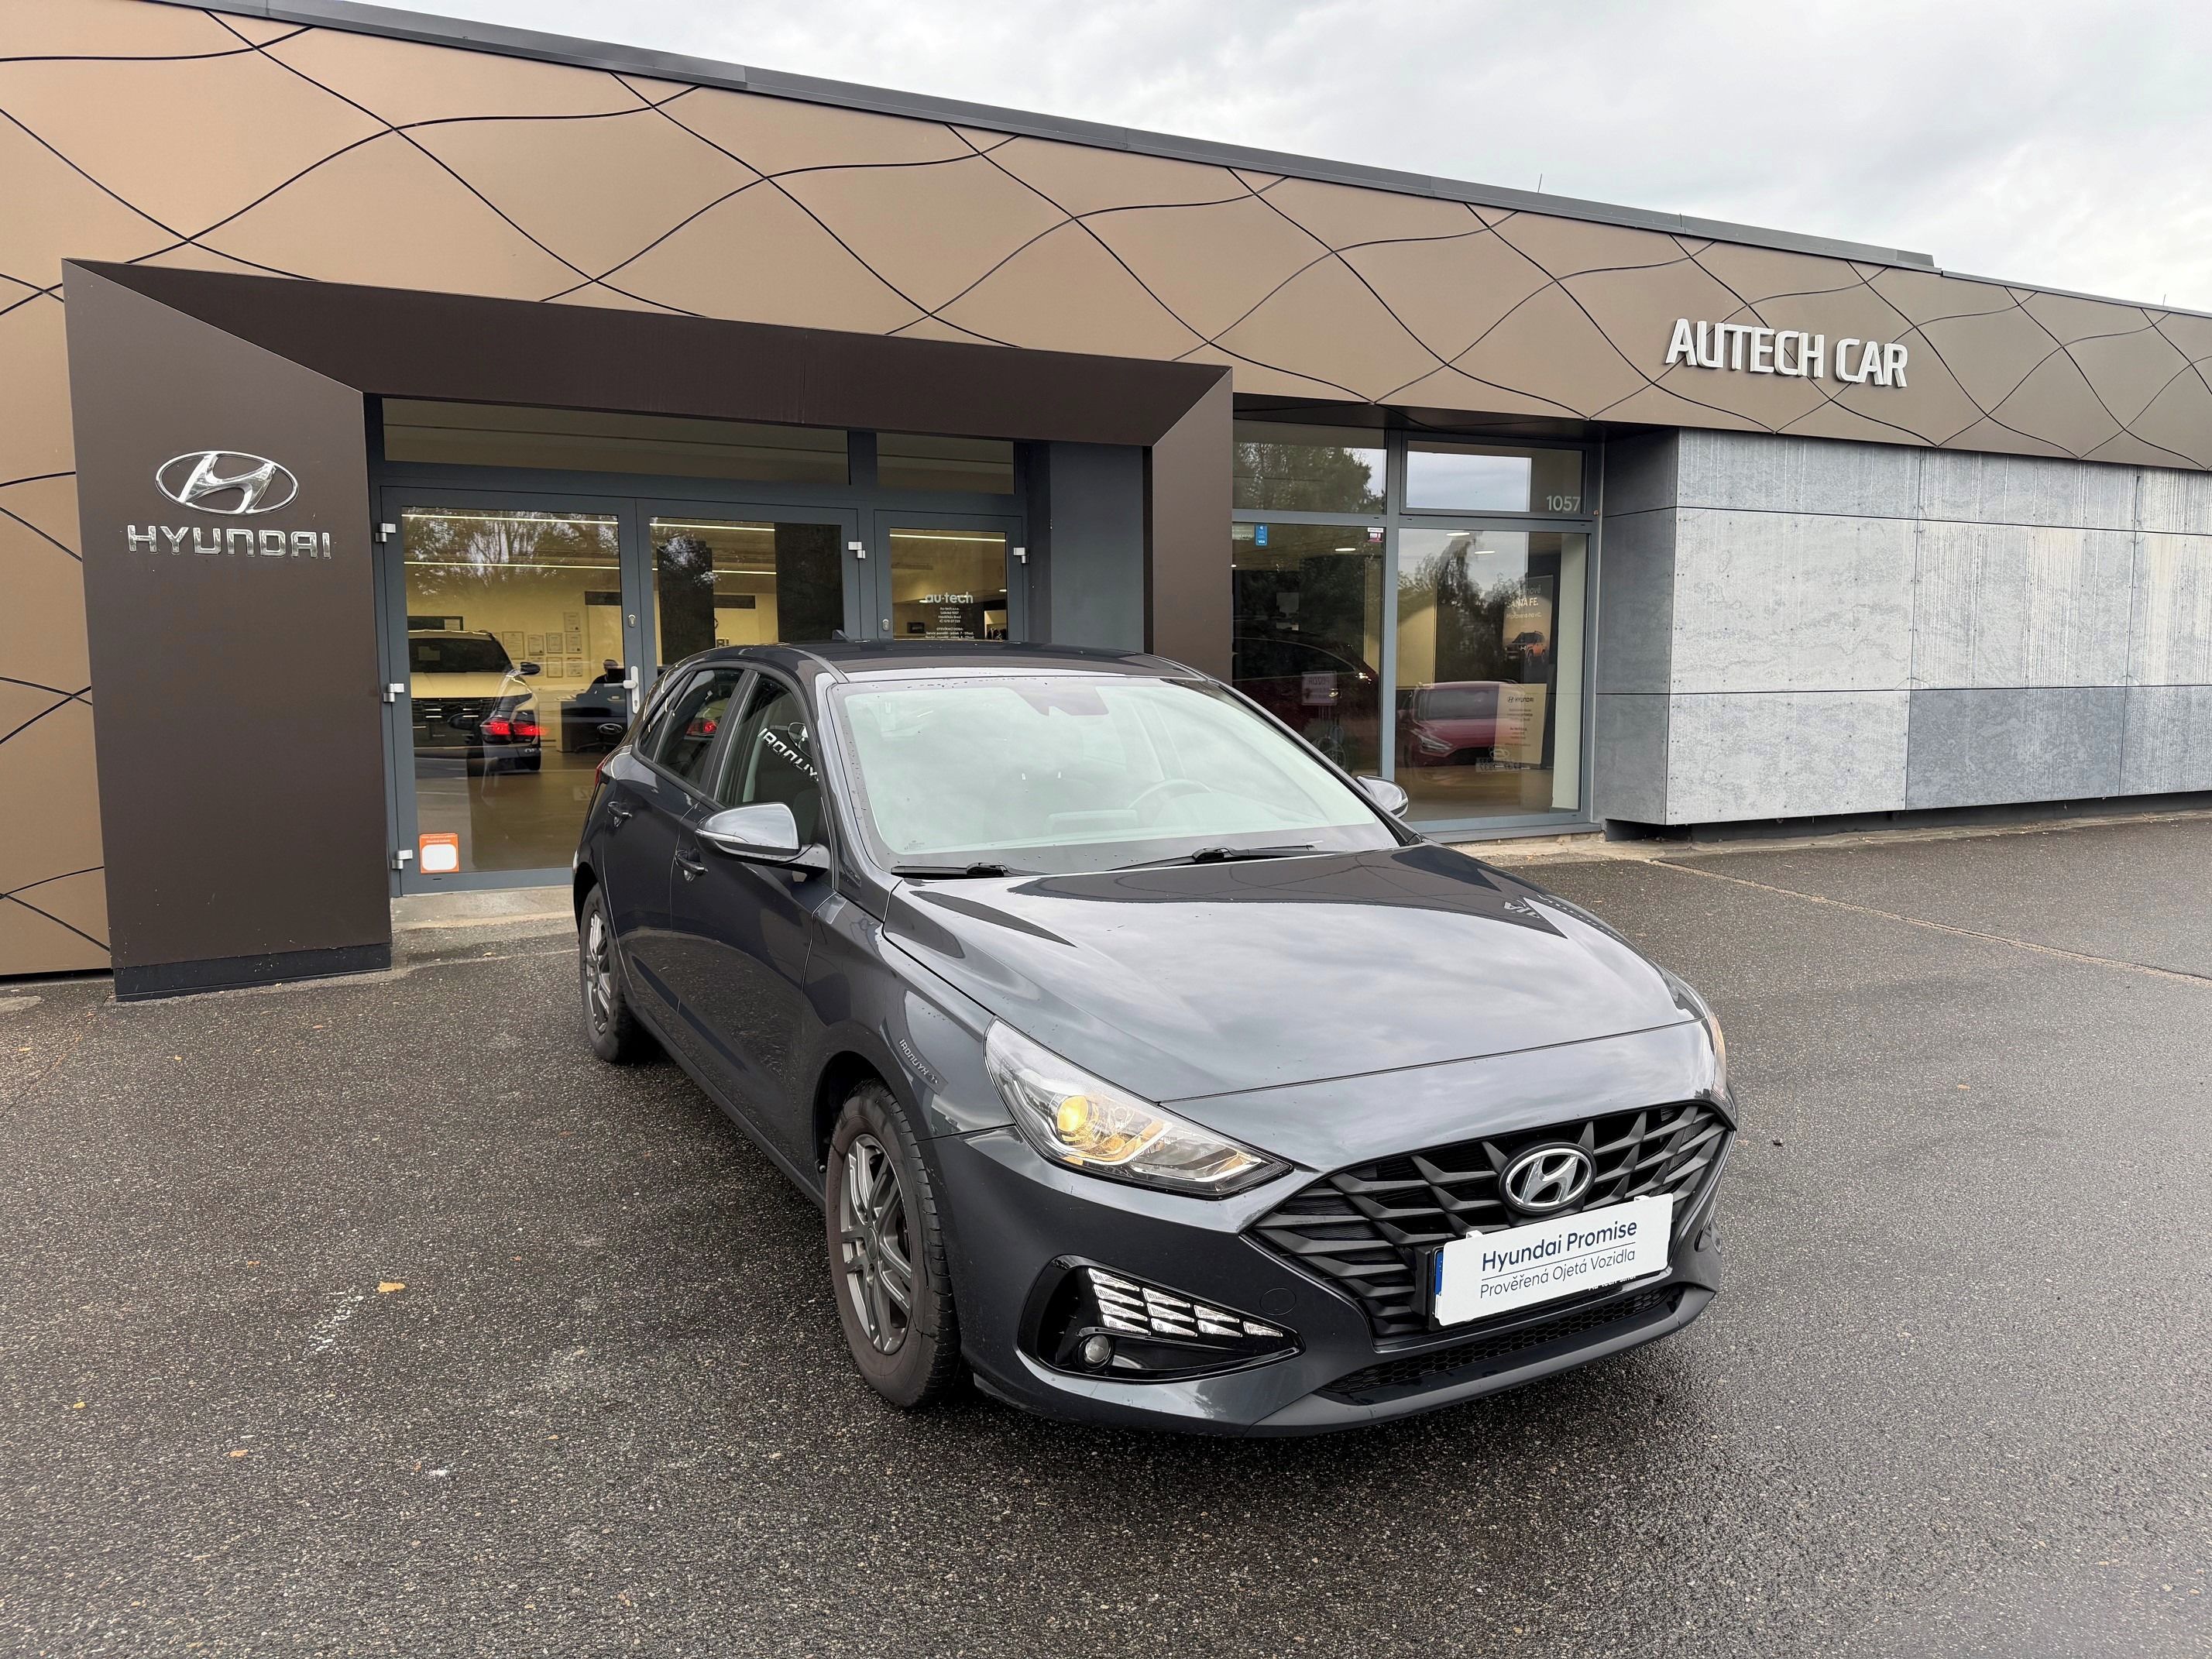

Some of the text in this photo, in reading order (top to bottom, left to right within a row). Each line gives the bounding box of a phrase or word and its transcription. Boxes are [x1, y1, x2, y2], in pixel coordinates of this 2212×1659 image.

[1664, 318, 1908, 388] AUTECH CAR
[1546, 495, 1581, 511] 1057
[127, 524, 331, 560] HYUNDAI
[1506, 596, 1528, 608] SANTA
[1482, 1220, 1638, 1273] Hyundai Promise
[1480, 1268, 1549, 1299] Prověřená
[1552, 1258, 1587, 1283] Ojetá
[1590, 1248, 1636, 1271] Vozidla
